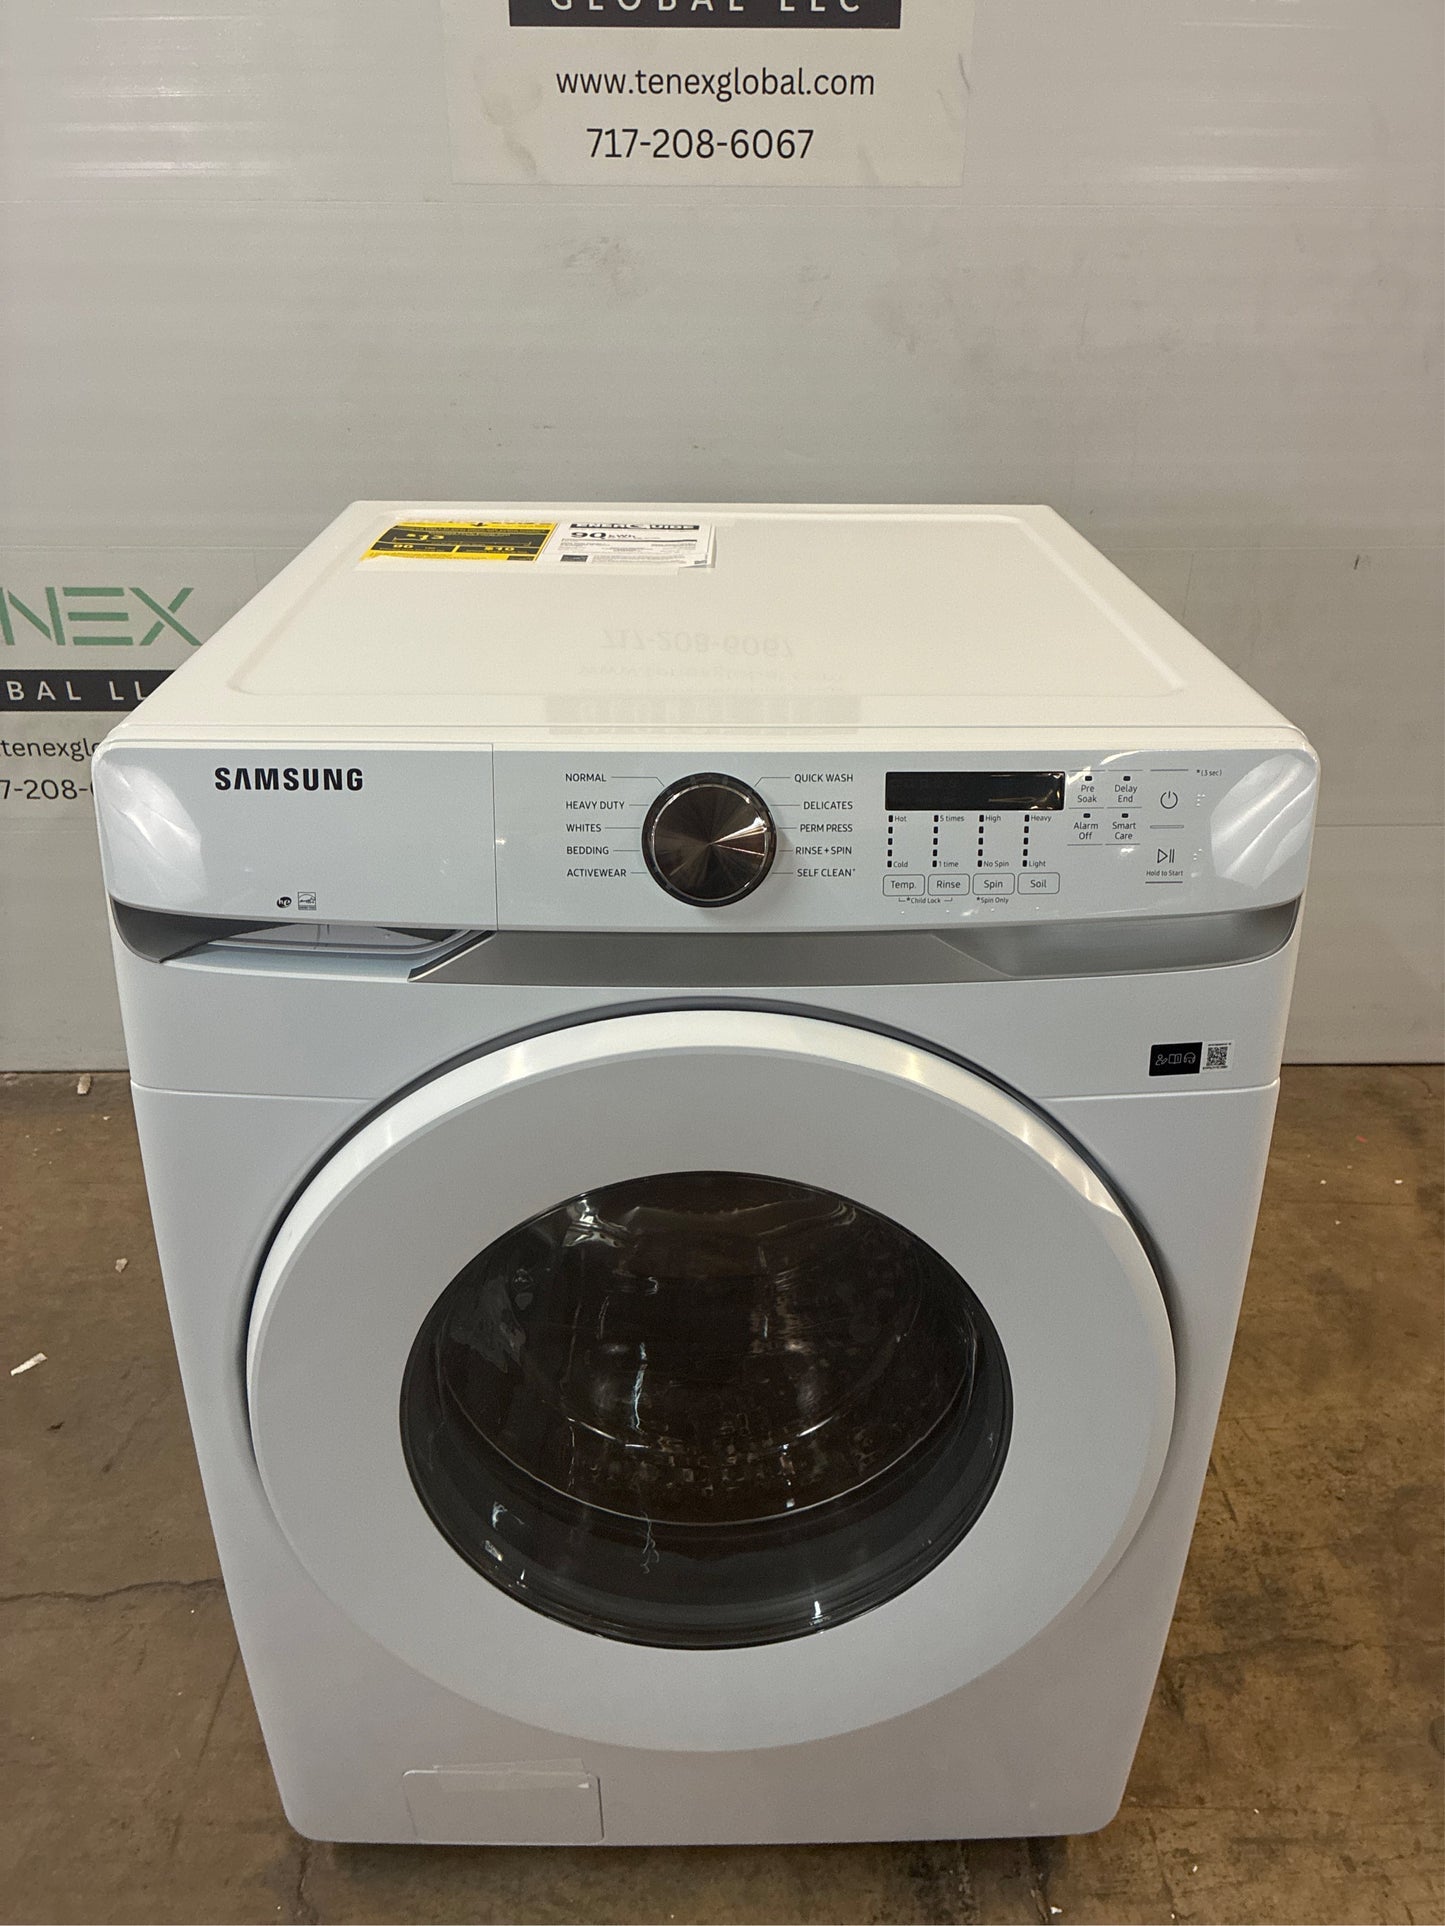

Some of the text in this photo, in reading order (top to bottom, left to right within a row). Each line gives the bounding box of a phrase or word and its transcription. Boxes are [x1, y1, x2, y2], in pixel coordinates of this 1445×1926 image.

[556, 66, 875, 102] www.tenexglobal.com
[586, 128, 815, 159] 717-208-6067
[0, 587, 203, 646] NEX
[214, 767, 363, 791] SAMSUNG
[565, 773, 607, 782] NORMAL
[794, 773, 854, 783] QUICK WASH
[0, 779, 94, 800] 7-208-
[1080, 784, 1095, 793] Pre
[1114, 784, 1138, 794] Delay
[1077, 794, 1097, 803] Soak
[1117, 794, 1134, 803] End
[565, 801, 625, 810] HEAVY DUTY
[803, 801, 853, 810] DELICATES
[985, 815, 1002, 824] High
[1030, 815, 1052, 823] Heavy
[566, 823, 602, 833] WHITES
[800, 823, 853, 833] PERM PRESS
[1073, 821, 1099, 830] Alarm
[1112, 821, 1137, 830] Smart
[1078, 831, 1093, 840] Off
[1114, 831, 1133, 840] Care
[566, 846, 609, 855] BEDDING
[795, 846, 823, 855] RINSE
[830, 846, 852, 855] SPIN
[994, 861, 1010, 869] Spin
[1028, 860, 1046, 868] Light
[566, 868, 627, 878] ACTIVEWEAR
[797, 868, 819, 877] SELF
[1145, 869, 1184, 877] Hold to Start
[890, 880, 917, 890] Temp.
[936, 880, 961, 889] Rinse
[983, 879, 1004, 890] Spin
[1030, 879, 1047, 889] Soil
[993, 896, 1009, 904] Only
